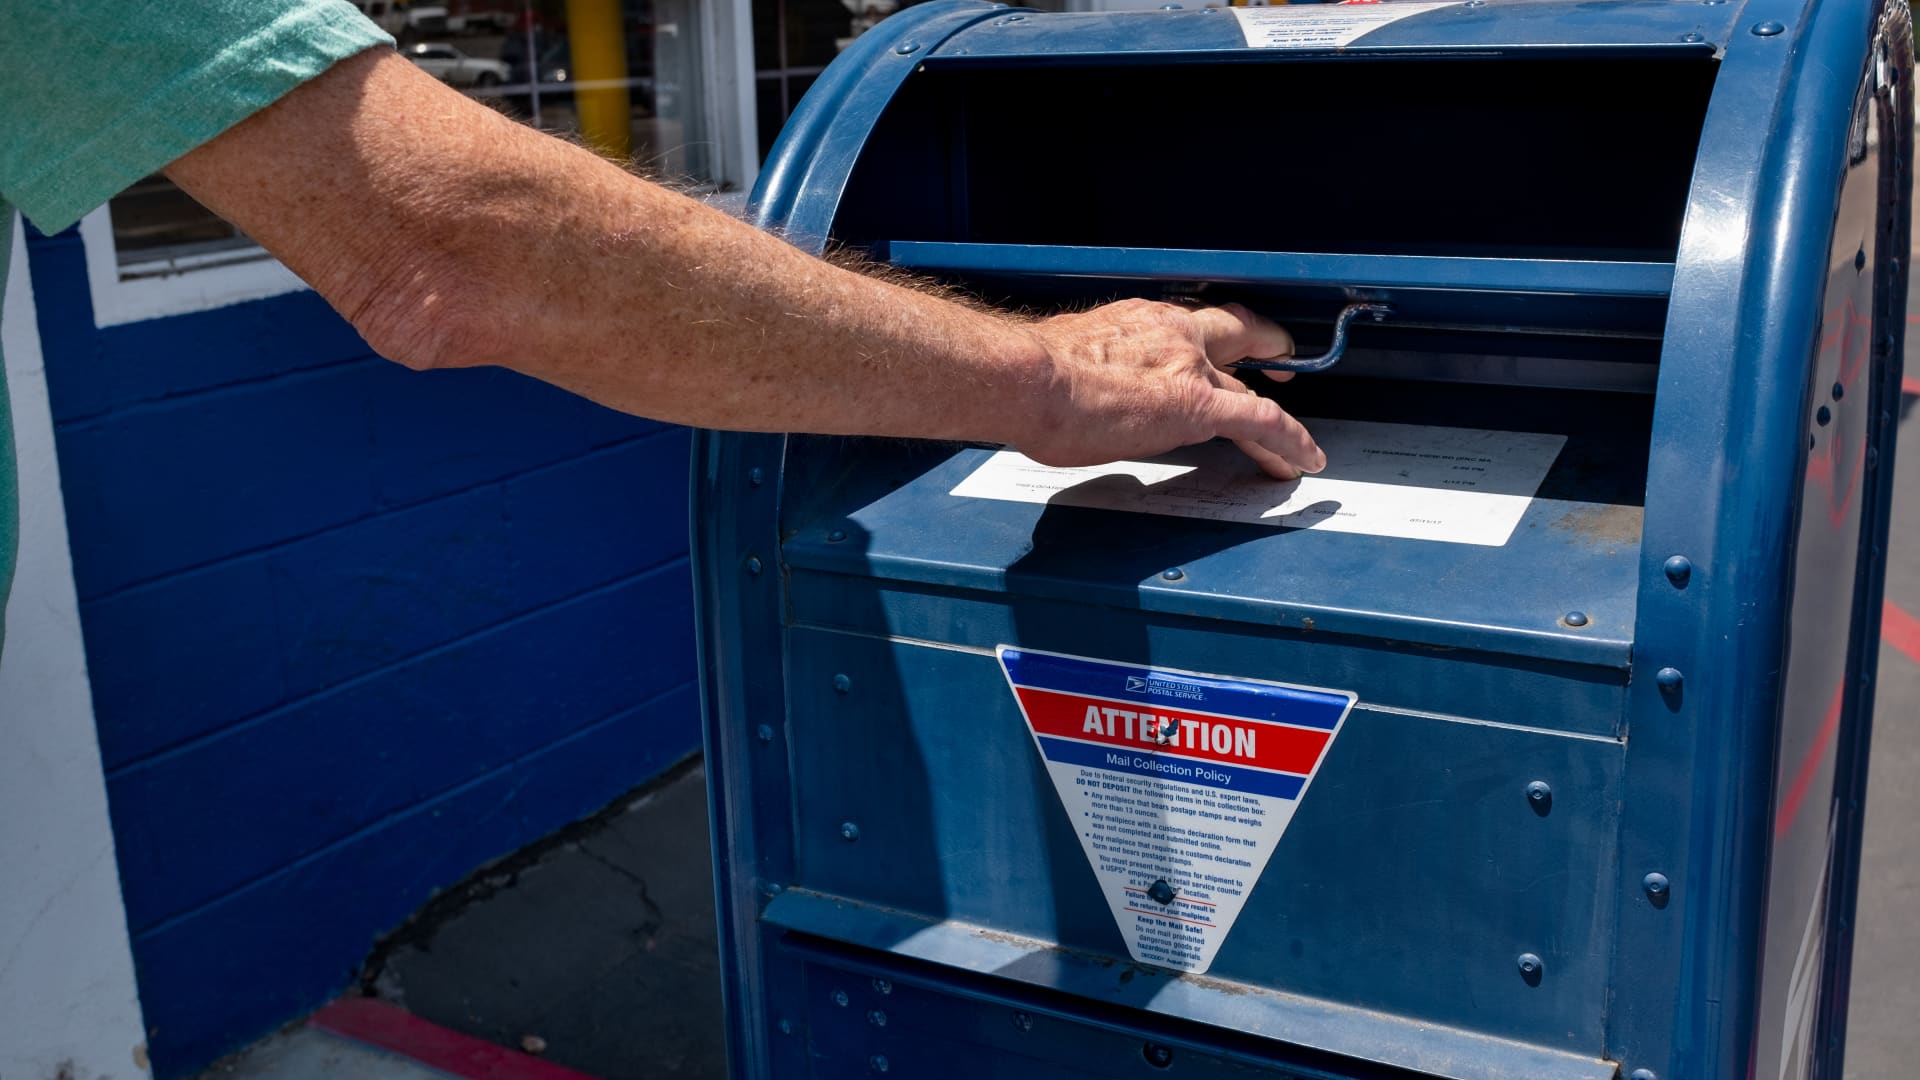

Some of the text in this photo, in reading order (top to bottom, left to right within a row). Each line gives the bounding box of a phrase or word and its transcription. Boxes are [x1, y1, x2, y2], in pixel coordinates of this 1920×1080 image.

[1147, 687, 1173, 696] POSTAL
[1149, 679, 1201, 692] UNITED STATES
[1082, 704, 1256, 758] ATTENTION
[1106, 752, 1231, 784] Mail Collection Policy
[1087, 780, 1100, 788] NOT
[1102, 782, 1130, 793] DEPOSIT
[1132, 787, 1142, 795] the
[1144, 789, 1173, 801] following
[1175, 794, 1193, 803] items
[1203, 799, 1215, 807] this
[1217, 803, 1249, 813] collection
[1102, 773, 1124, 782] federal
[1126, 778, 1151, 788] security
[1153, 783, 1189, 793] regulations
[1220, 793, 1240, 801] export
[1091, 792, 1102, 801] Any
[1137, 799, 1149, 807] that
[1170, 806, 1196, 816] postage
[1198, 810, 1222, 820] stamps
[1109, 804, 1123, 812] than
[1092, 812, 1103, 822] Any
[1158, 825, 1185, 834] customs
[1187, 829, 1223, 841] declaration
[1225, 835, 1240, 844] form
[1242, 838, 1256, 847] that
[1118, 828, 1151, 838] completed
[1092, 833, 1104, 842] Any
[1137, 840, 1150, 849] that
[1152, 845, 1177, 854] requires
[1185, 851, 1213, 860] customs
[1215, 854, 1251, 867] declaration
[1092, 842, 1107, 850] form
[1141, 852, 1166, 861] postage
[1129, 861, 1153, 870] present
[1154, 865, 1172, 873] these
[1204, 874, 1234, 885] shipment
[1192, 882, 1215, 891] service
[1217, 887, 1241, 895] counter
[1176, 901, 1189, 909] may
[1169, 921, 1183, 930] Mail
[1172, 933, 1204, 944] prohibited
